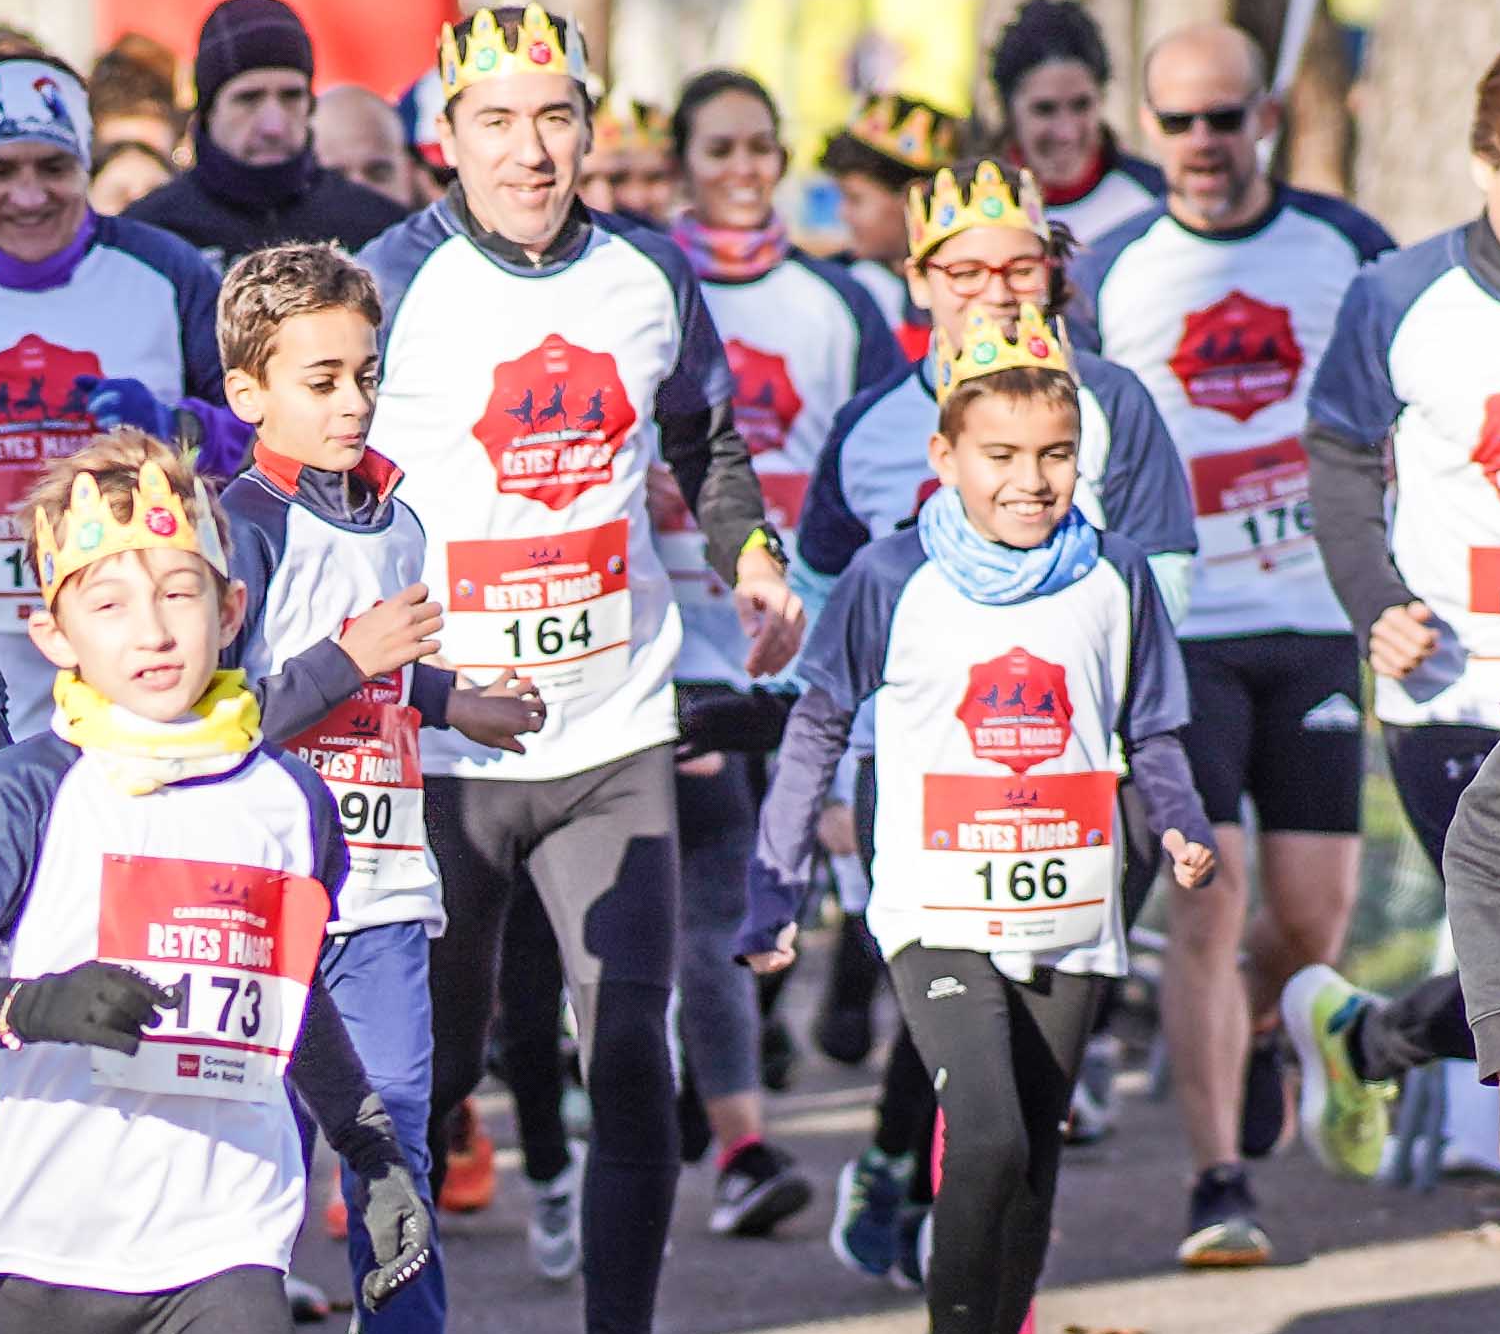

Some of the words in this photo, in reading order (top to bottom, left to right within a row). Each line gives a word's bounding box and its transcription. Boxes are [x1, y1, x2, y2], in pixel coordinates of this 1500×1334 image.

[503, 608, 592, 658] 164
[974, 857, 1068, 902] 166
[147, 922, 222, 962] REYES
[174, 972, 262, 1038] 173
